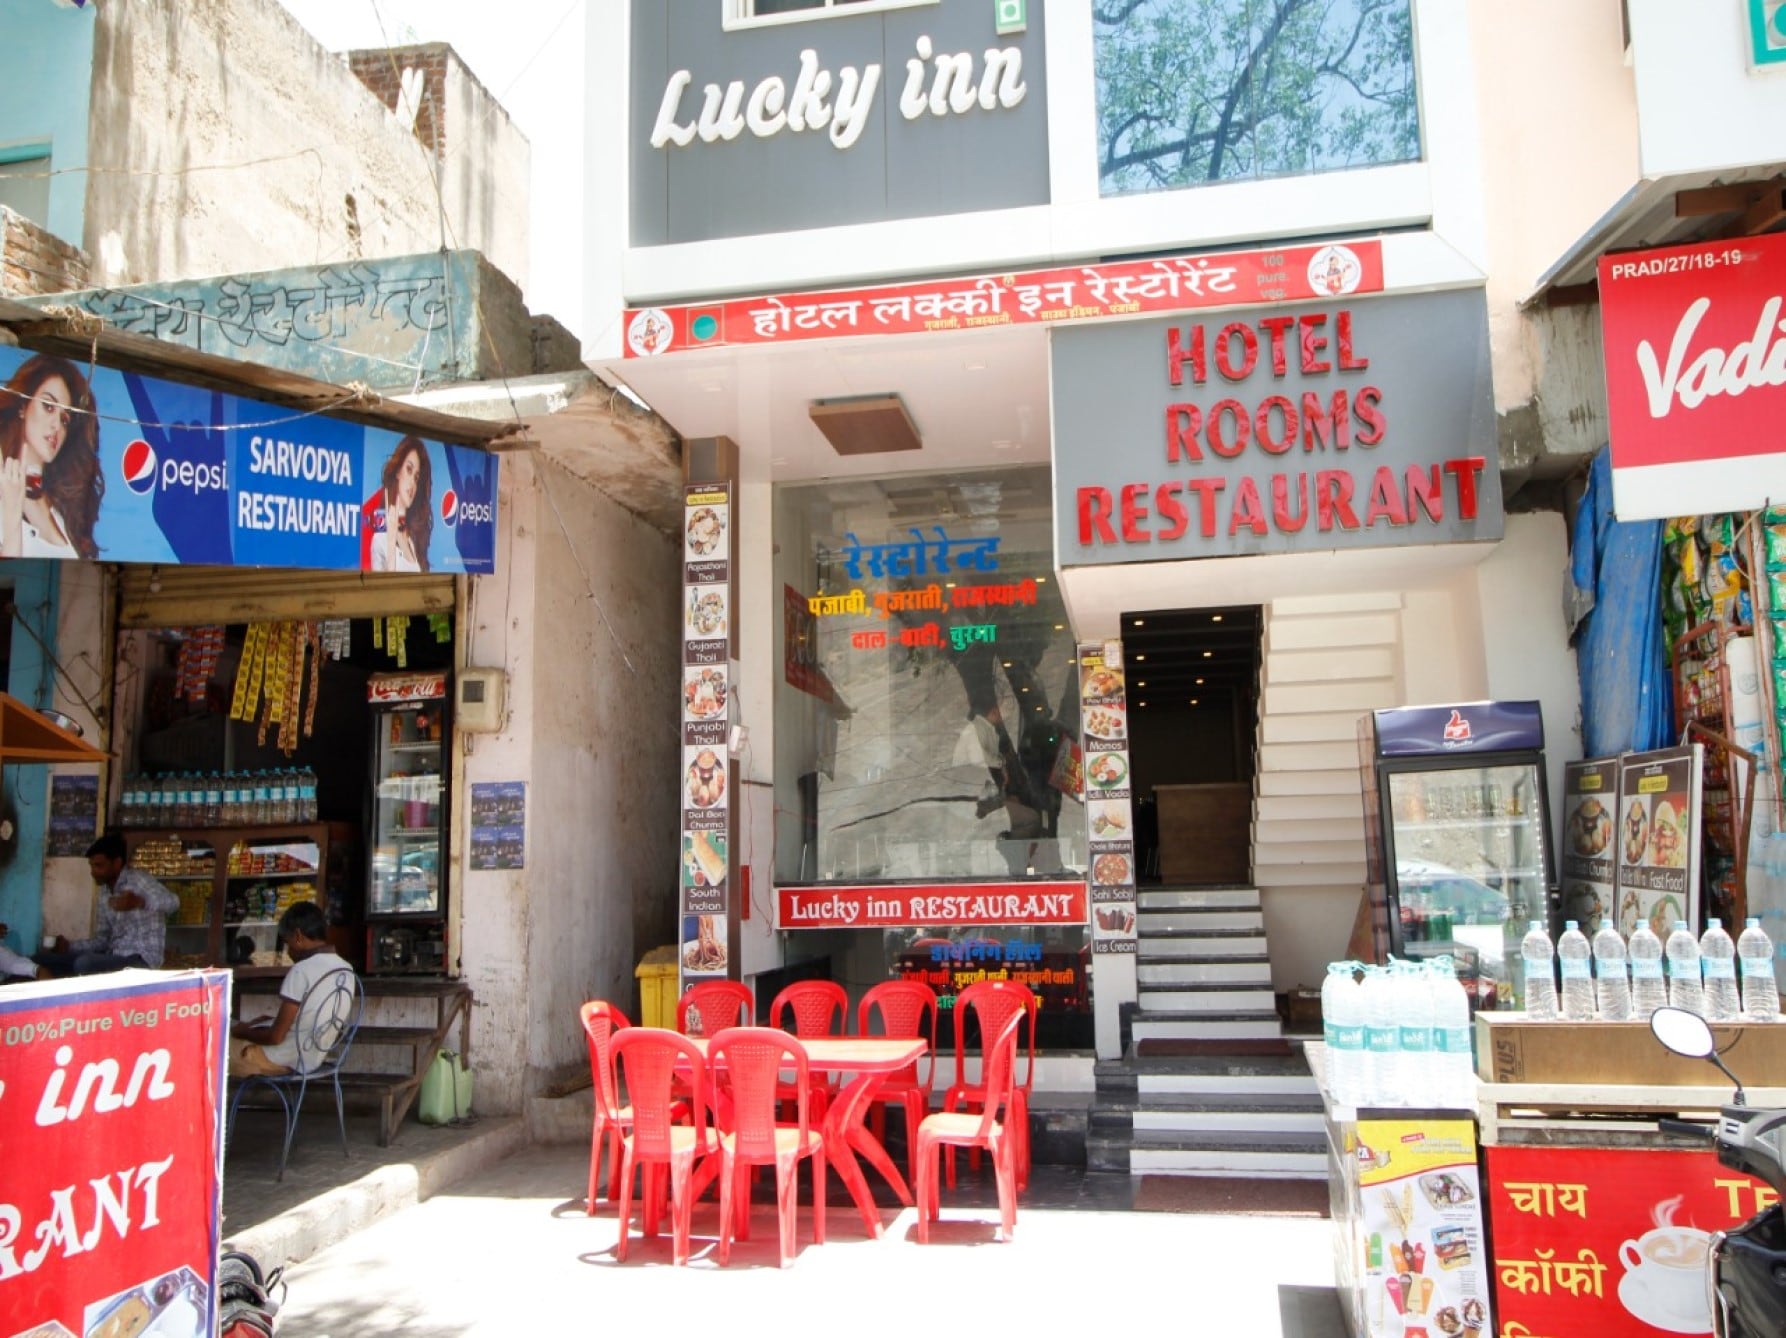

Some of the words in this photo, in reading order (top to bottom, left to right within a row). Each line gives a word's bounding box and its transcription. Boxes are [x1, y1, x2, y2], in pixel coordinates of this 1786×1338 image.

[650, 49, 881, 149] Lucky
[899, 35, 1026, 120] inn
[1262, 254, 1284, 267] 100
[1612, 249, 1742, 280] PRAD/27/18-19
[749, 298, 862, 338] होटल
[869, 278, 1007, 324] लक्की
[1012, 281, 1076, 318] इन
[1084, 258, 1238, 306] रेस्टोरेंट
[1166, 310, 1369, 386] HOTEL
[1165, 386, 1388, 463] ROOMS
[249, 436, 352, 486] SARVODYA
[238, 491, 361, 538] RESTAURANT
[1076, 457, 1486, 547] RESTAURANT
[842, 525, 1001, 580] रेस्टोरेन्ट
[688, 641, 725, 652] Gujarati
[950, 625, 997, 652] चुरमा
[696, 653, 717, 662] Thali
[687, 723, 725, 735] Punjabi
[694, 735, 719, 744] Thali
[1089, 741, 1122, 752] Momos
[689, 888, 720, 898] South
[1665, 873, 1684, 892] Food
[688, 902, 722, 911] Indian
[790, 895, 860, 923] Lucky
[866, 896, 902, 918] inn
[909, 893, 1074, 920] RESTAURANT
[1096, 940, 1108, 952] Ice
[1110, 940, 1136, 952] Cream
[119, 1007, 159, 1028] Veg
[35, 1045, 175, 1126] inn
[1503, 1182, 1589, 1219] चाय
[1495, 1248, 1608, 1299] कॉफी
